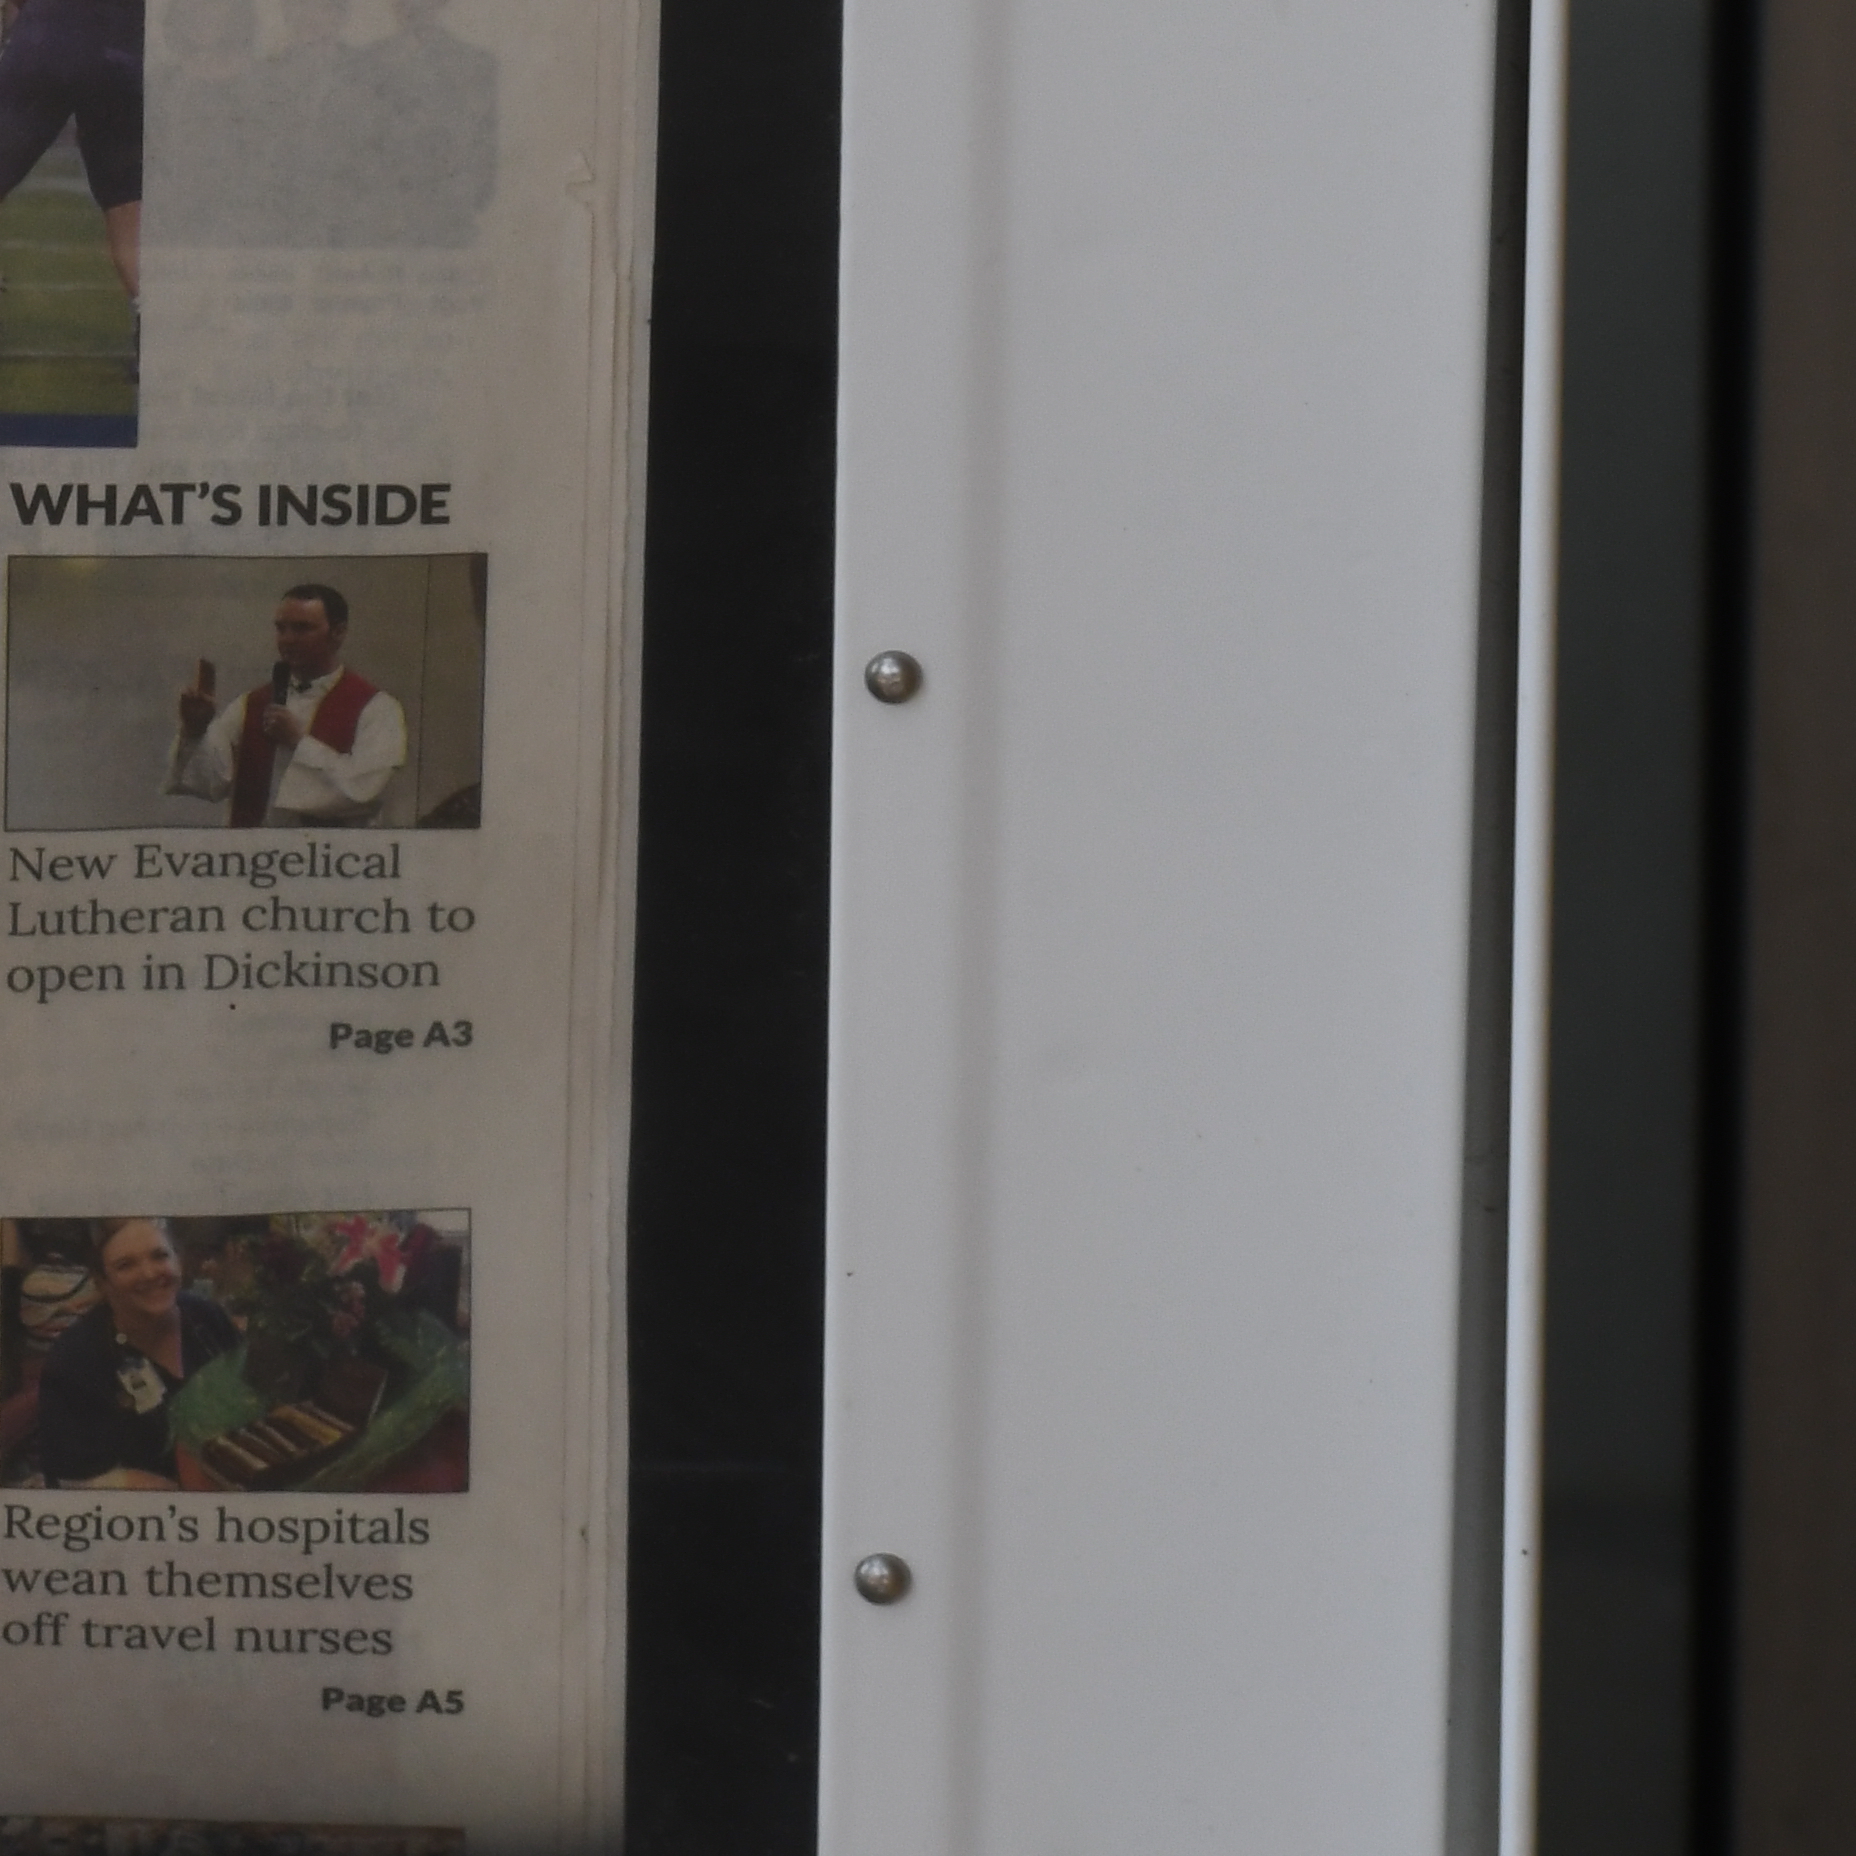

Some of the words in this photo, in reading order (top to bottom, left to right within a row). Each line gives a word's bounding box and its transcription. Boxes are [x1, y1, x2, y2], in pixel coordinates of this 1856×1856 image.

[257, 482, 451, 527] INSIDE
[8, 846, 118, 882] New
[132, 841, 401, 889] Evangelical
[7, 897, 226, 937] Lutheran
[240, 894, 411, 934] church
[426, 901, 475, 933] to
[5, 963, 126, 1005] open
[141, 953, 186, 991] in
[202, 948, 440, 991] Dickinson
[328, 1021, 415, 1055] Page
[421, 1019, 473, 1048] A3
[215, 1505, 430, 1556] hospitals
[0, 1567, 128, 1597] wean
[144, 1559, 413, 1601] themselves
[0, 1610, 69, 1646] off
[80, 1615, 215, 1652] travel
[233, 1626, 394, 1656] nurses
[320, 1686, 407, 1718] Page
[413, 1688, 465, 1715] A5
